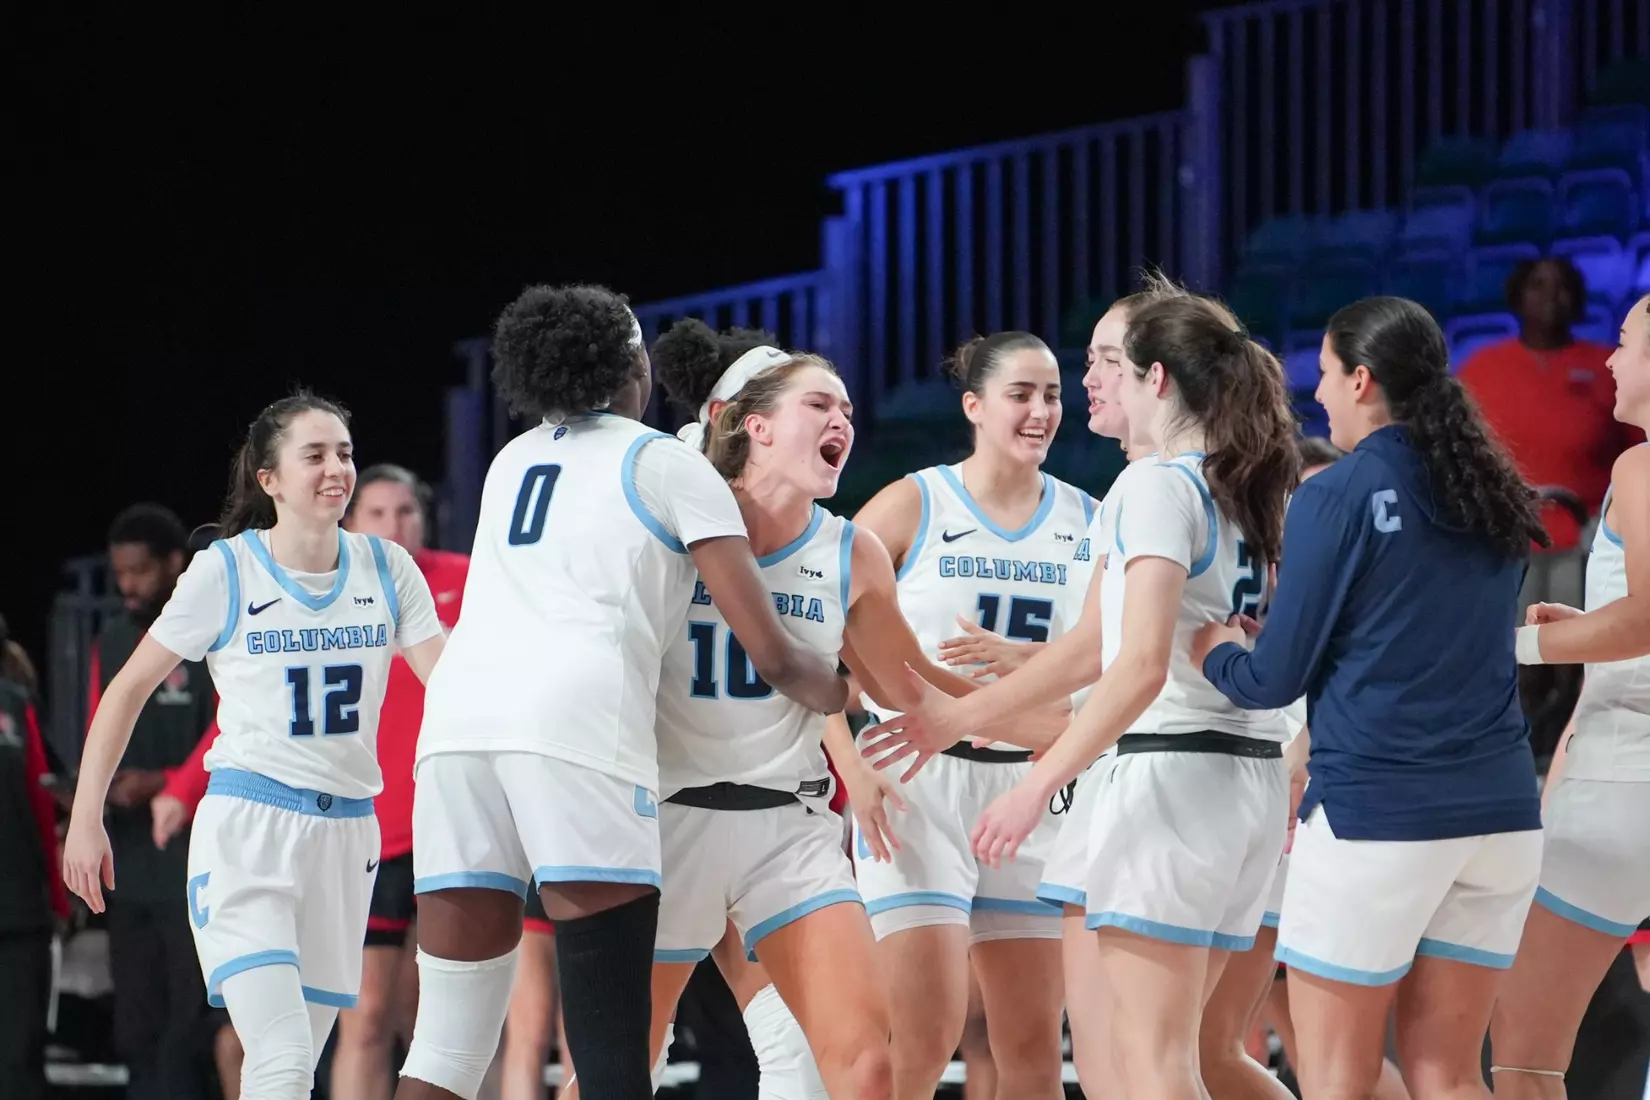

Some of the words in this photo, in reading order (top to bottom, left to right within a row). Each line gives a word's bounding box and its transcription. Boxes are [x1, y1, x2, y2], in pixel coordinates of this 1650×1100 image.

[508, 464, 562, 546] 0
[1372, 489, 1402, 533] C
[939, 556, 1067, 585] COLUMBI
[247, 624, 387, 654] COLUMBIA
[976, 593, 1054, 643] 15
[285, 662, 363, 737] 12
[189, 871, 211, 929] C
